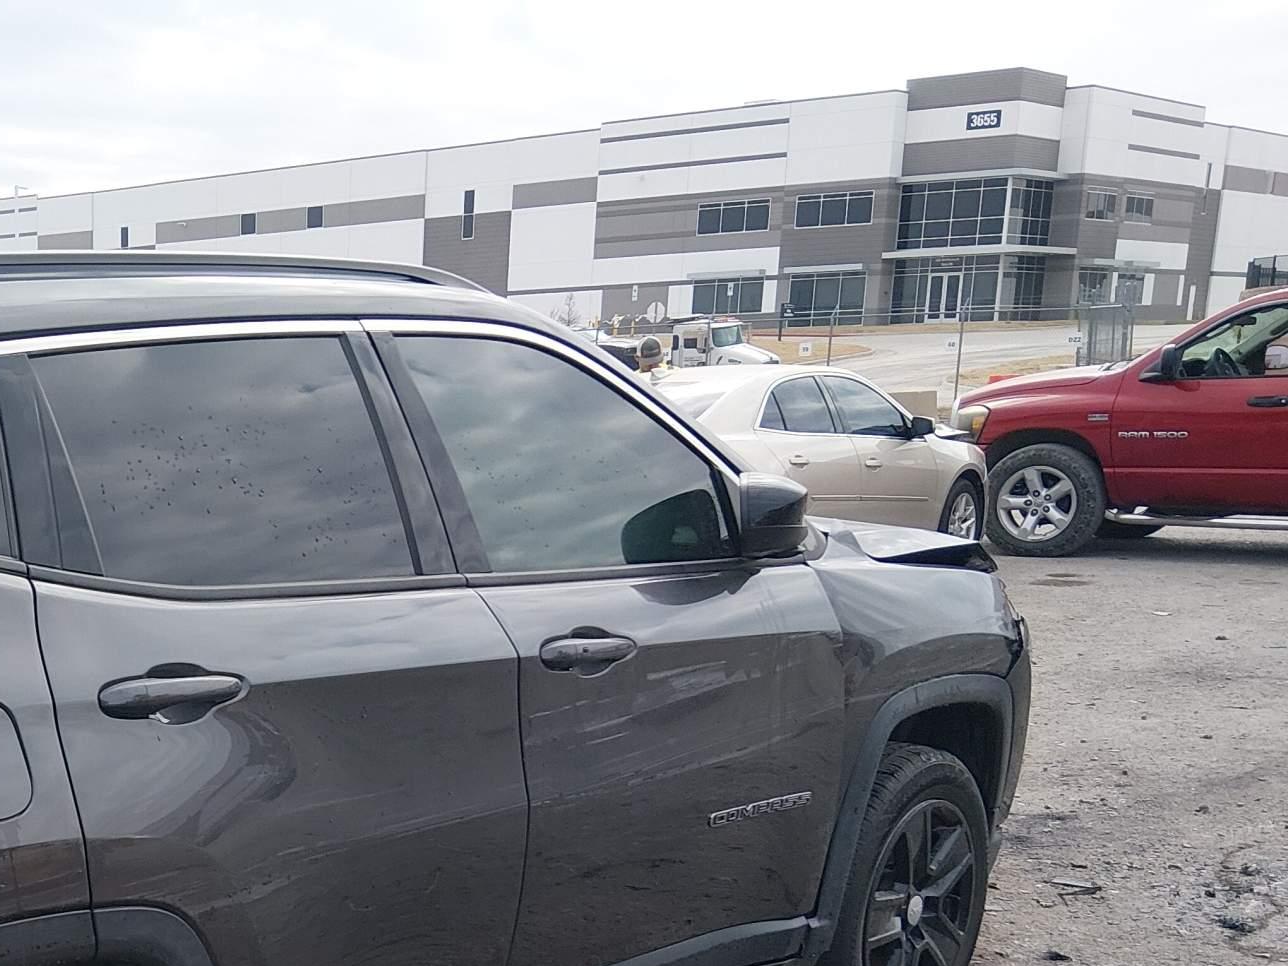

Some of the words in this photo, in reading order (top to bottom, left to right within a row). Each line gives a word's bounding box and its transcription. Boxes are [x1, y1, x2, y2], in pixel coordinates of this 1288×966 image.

[970, 113, 998, 127] 3655
[1118, 431, 1150, 439] RAM
[1153, 431, 1189, 439] 1500
